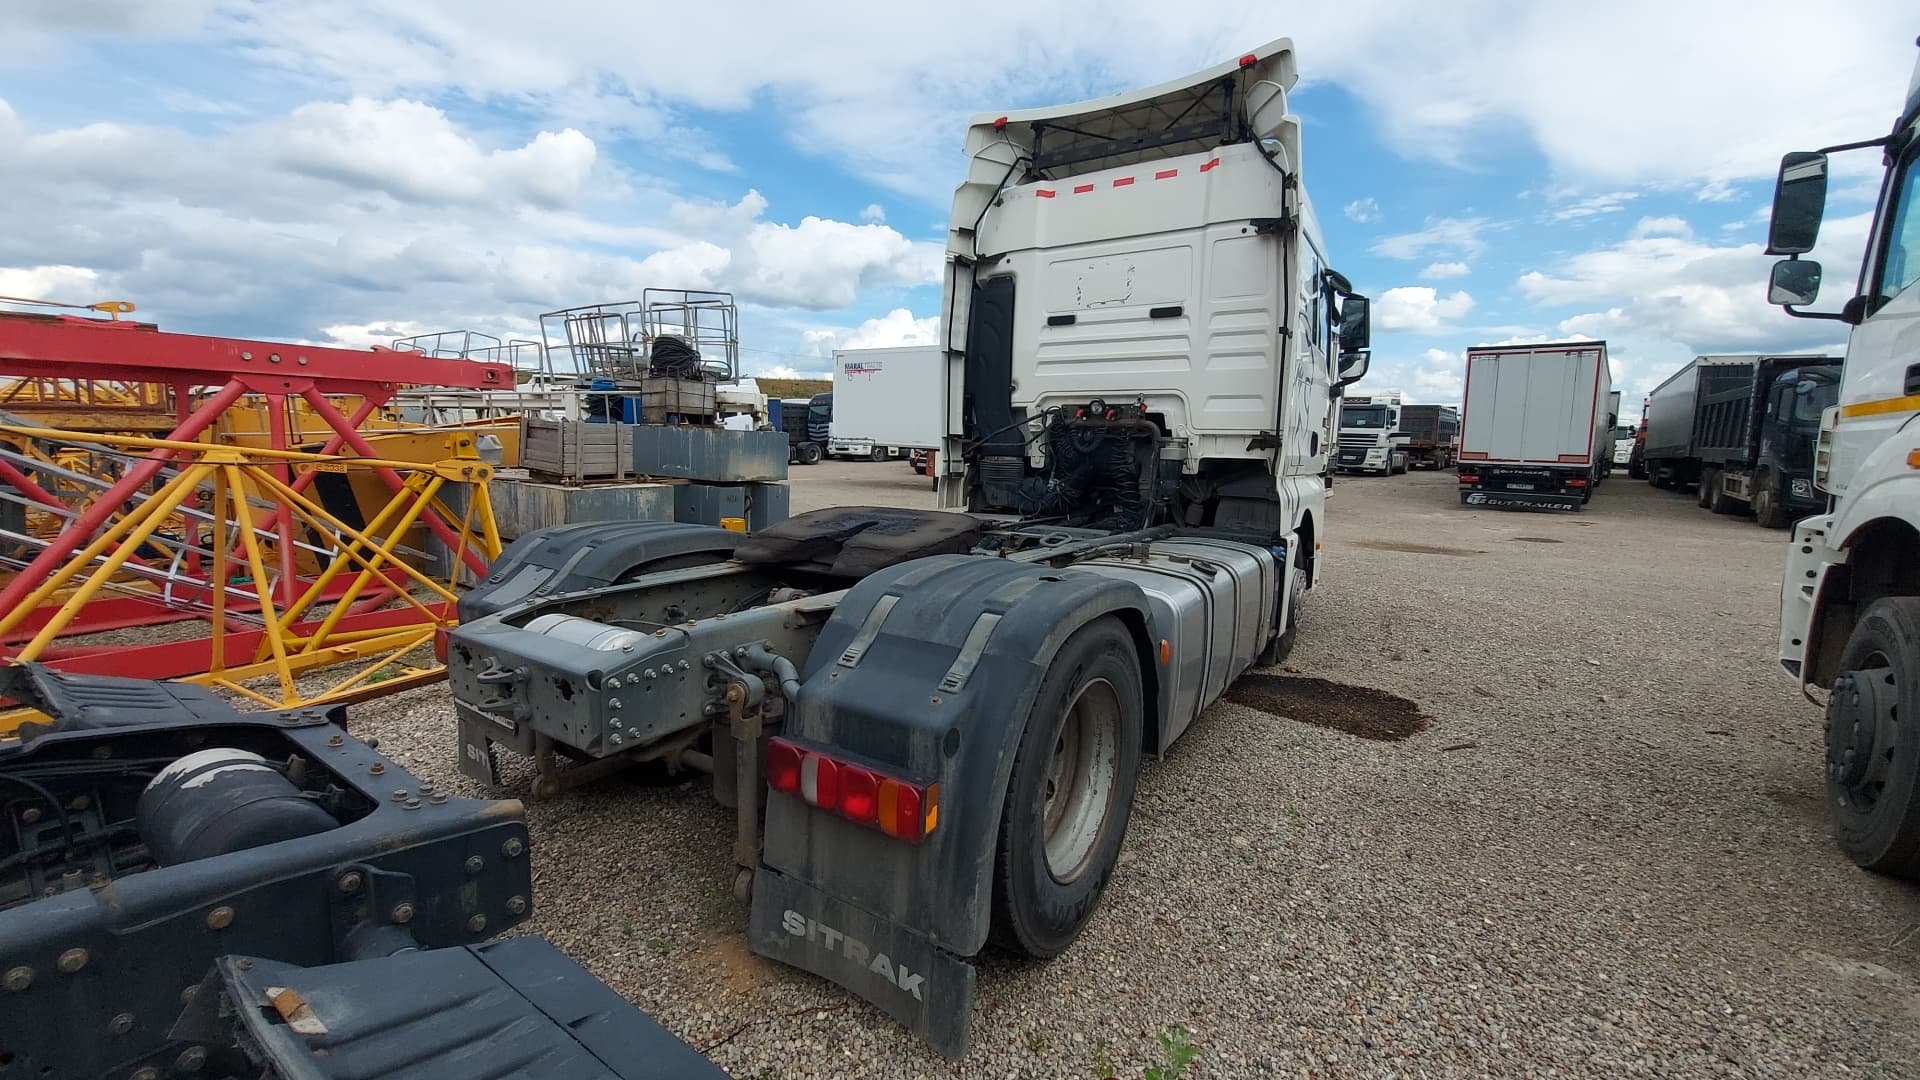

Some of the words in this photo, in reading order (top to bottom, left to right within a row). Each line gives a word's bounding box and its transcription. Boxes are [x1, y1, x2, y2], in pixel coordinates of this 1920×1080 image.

[1515, 500, 1573, 510] TRAILER
[466, 743, 490, 768] SIT
[782, 909, 927, 1002] SITRAK
